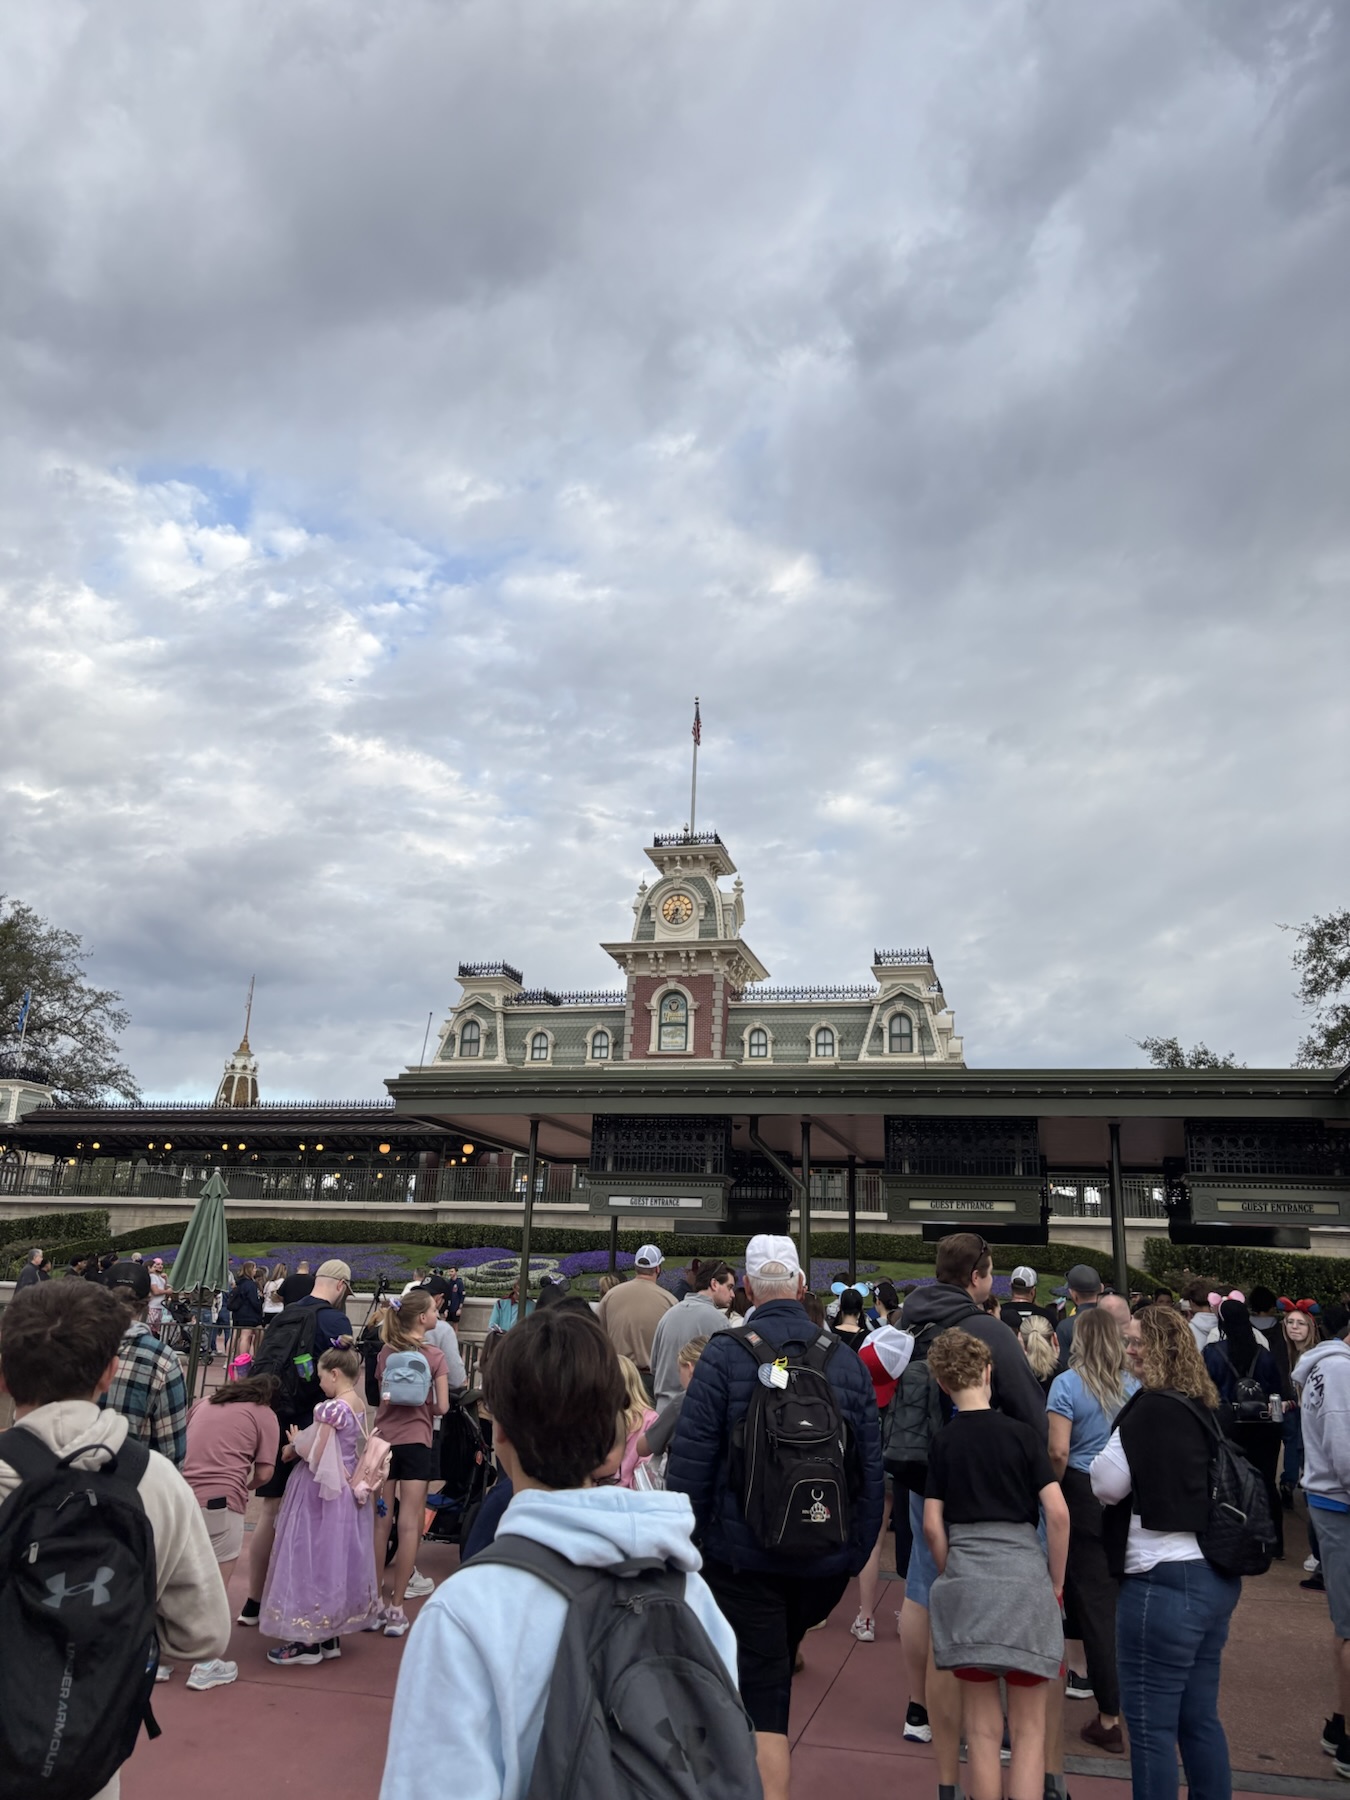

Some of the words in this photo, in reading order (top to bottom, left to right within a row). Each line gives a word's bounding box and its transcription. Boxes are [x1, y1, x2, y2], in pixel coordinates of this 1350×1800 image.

[630, 1197, 649, 1206] GUEST
[650, 1197, 680, 1207] ENTRANCE
[930, 1200, 954, 1209] GUEST
[956, 1201, 995, 1210] ENTRANCE
[1241, 1202, 1268, 1212] GUEST
[1271, 1203, 1314, 1214] ENTRANCE
[40, 1699, 69, 1778] ARMOUR
